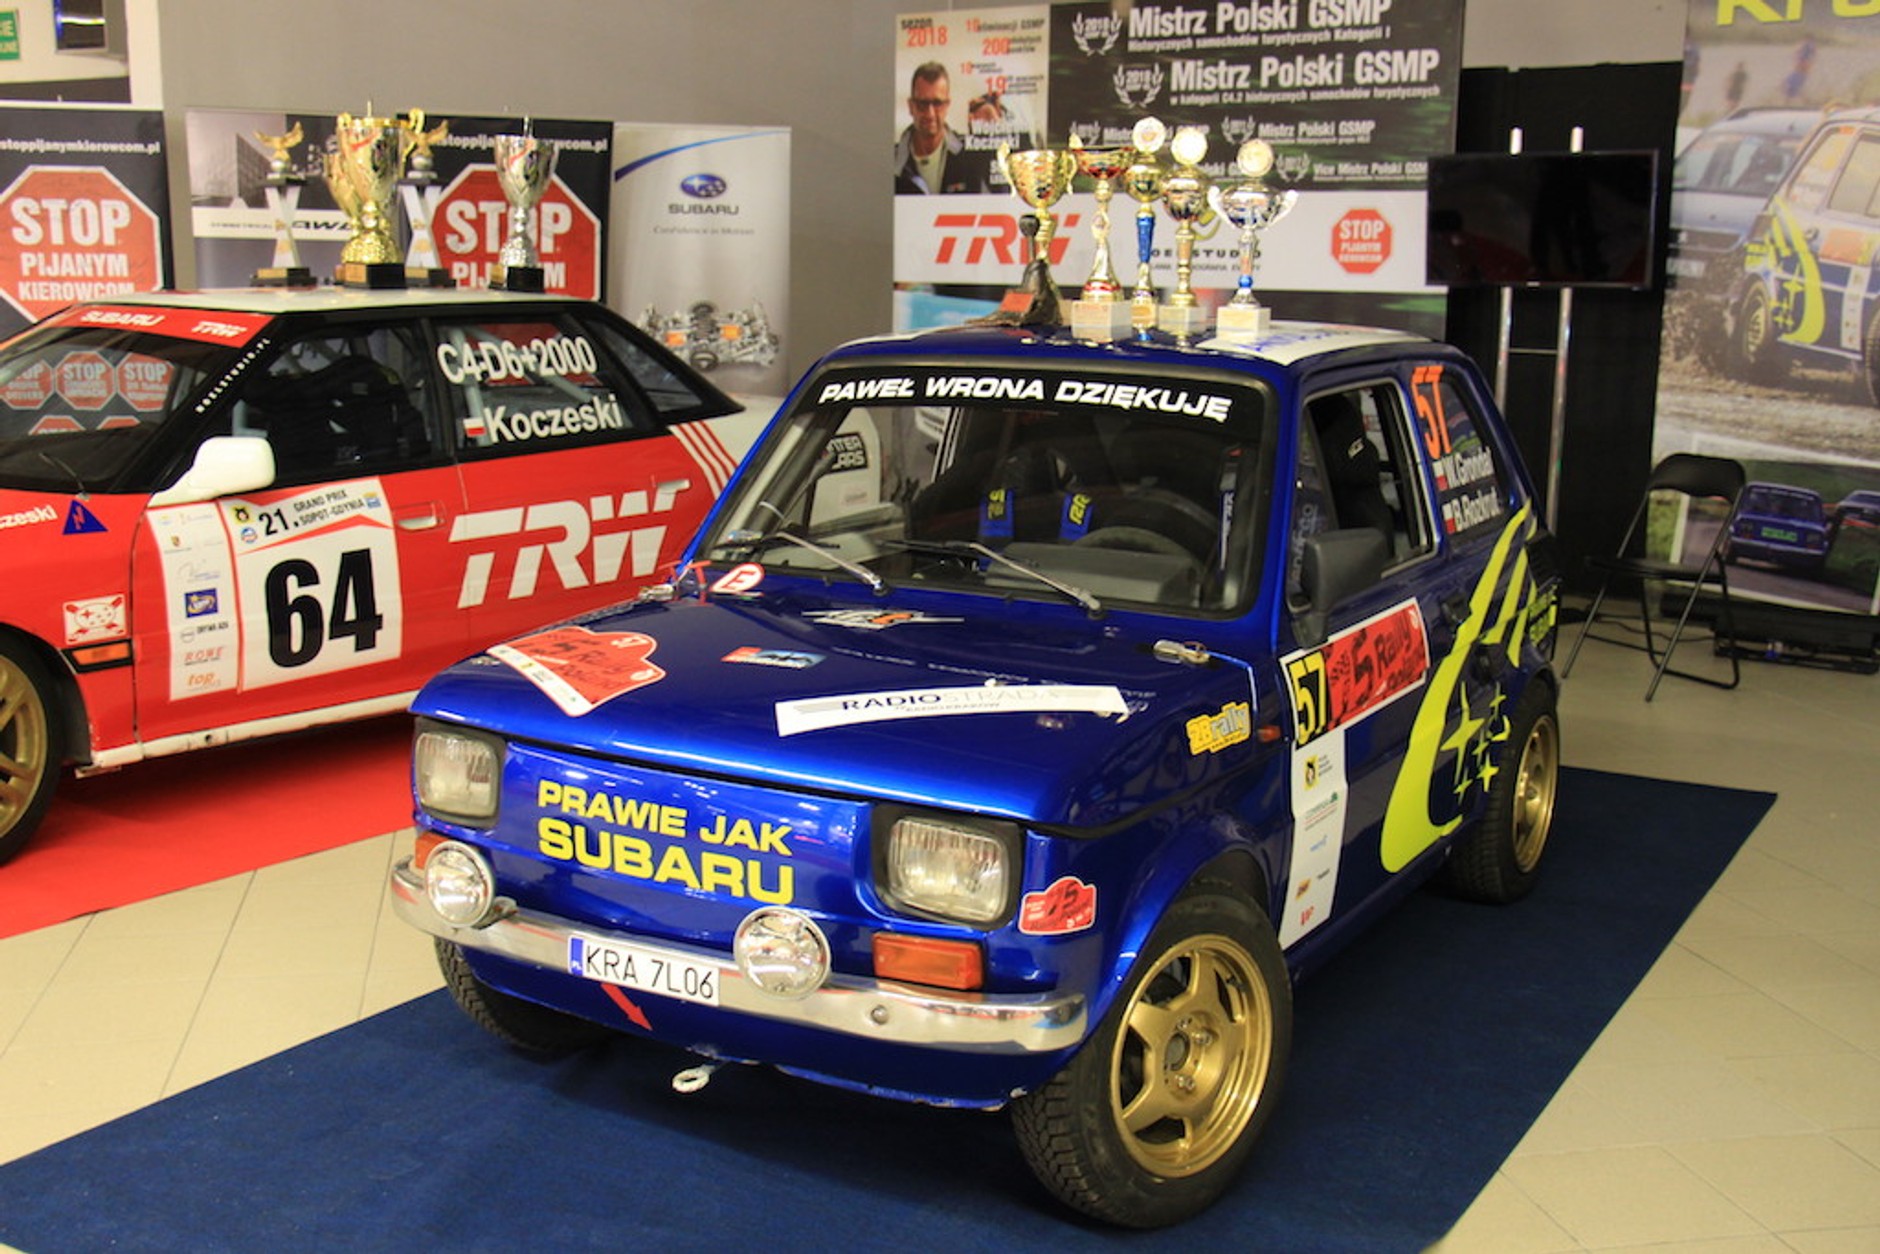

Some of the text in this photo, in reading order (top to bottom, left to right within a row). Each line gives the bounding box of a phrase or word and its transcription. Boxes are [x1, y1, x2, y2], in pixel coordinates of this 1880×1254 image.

[907, 26, 948, 47] 2018
[1129, 0, 1391, 37] Mistrz Polski GSMP
[1170, 49, 1440, 91] Mistrz Polski GSMP
[10, 197, 132, 246] STOP
[668, 203, 739, 215] SUBARU
[1340, 219, 1385, 239] STOP
[20, 252, 129, 278] PIJANYM
[452, 262, 566, 288] PIJM
[18, 281, 135, 301] KIEROWCOM
[81, 310, 164, 327] SUBARU
[192, 321, 247, 337] TRW
[63, 363, 106, 380] STOP
[125, 362, 167, 380] STOP
[437, 336, 597, 384] C4-D6+2000
[484, 393, 623, 442] Koczeski
[819, 376, 1232, 423] PAWEŁ WRONA DZIĘKUJĘ
[1411, 365, 1452, 459] 57
[293, 494, 325, 512] GRAND
[327, 490, 347, 504] PRIX
[300, 499, 364, 526] SOPOT-GDYNIA
[449, 488, 678, 609] TRW
[265, 547, 383, 667] 64
[1289, 650, 1326, 745] 57
[537, 780, 793, 856] PRAWIE JAK
[538, 817, 794, 905] SUBARU
[586, 946, 714, 1000] KRA 7L06
